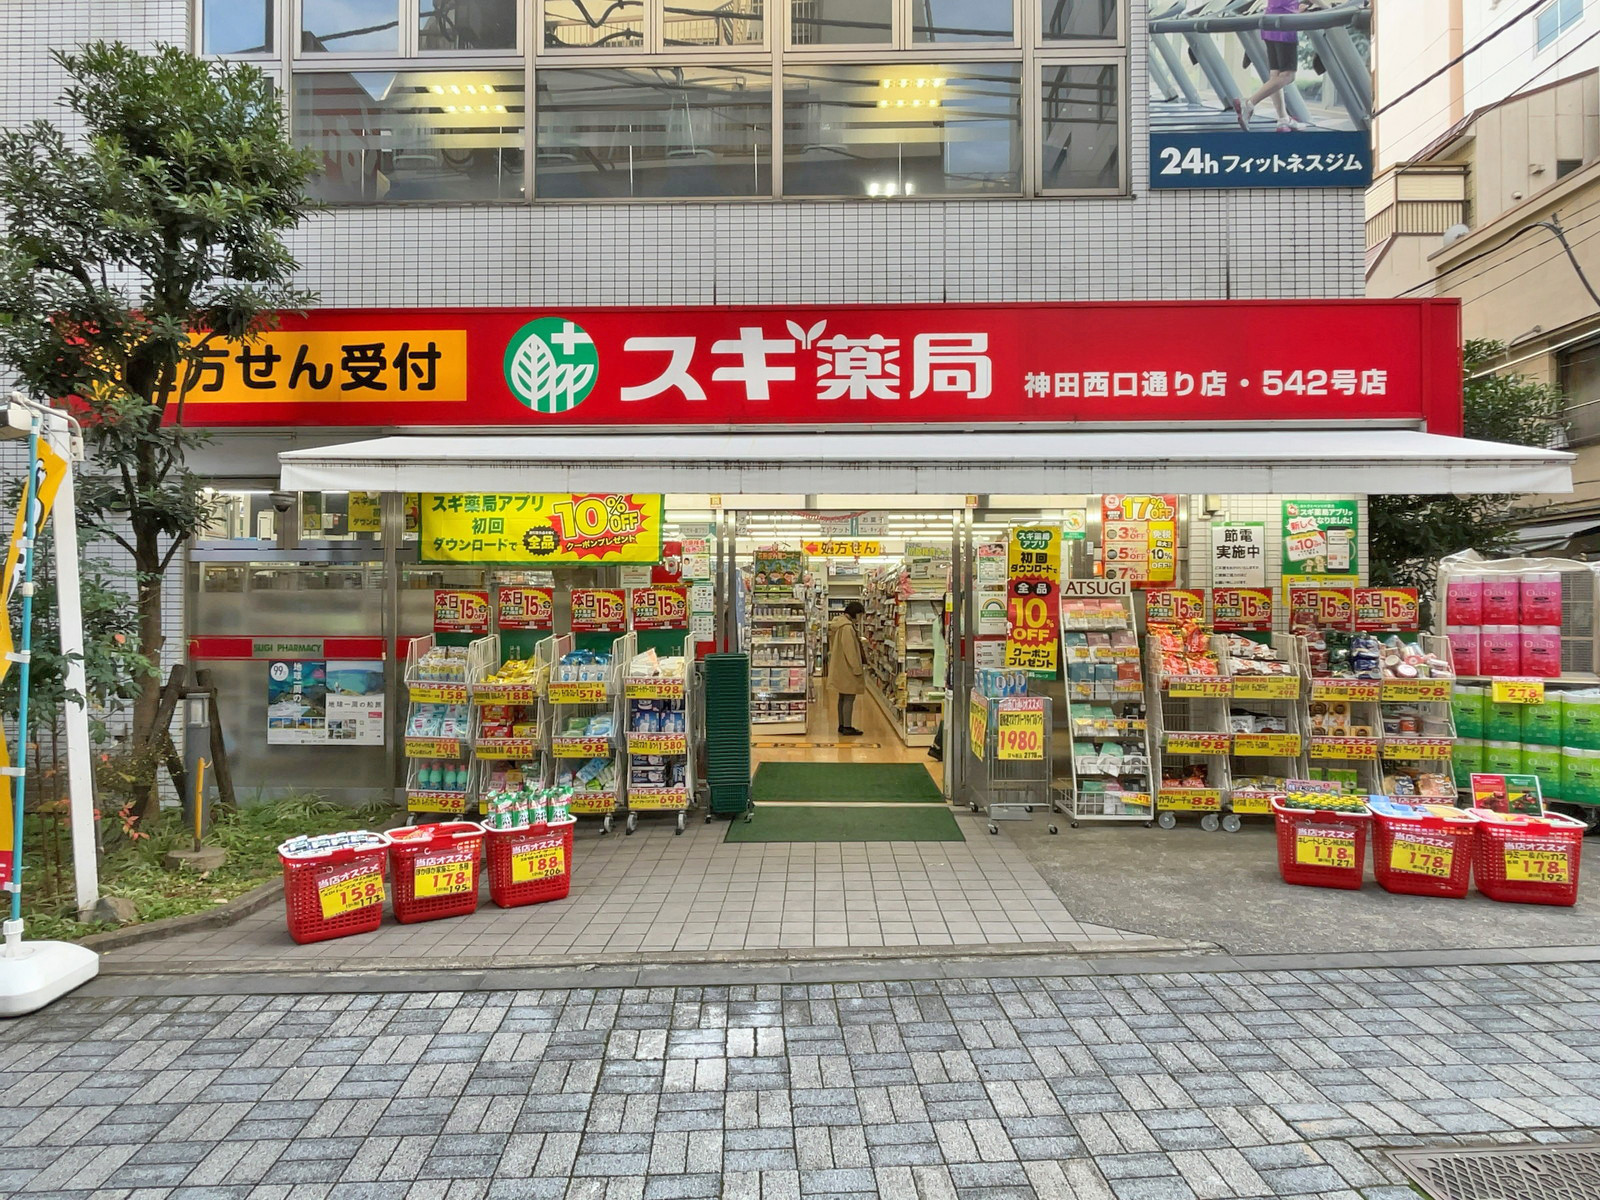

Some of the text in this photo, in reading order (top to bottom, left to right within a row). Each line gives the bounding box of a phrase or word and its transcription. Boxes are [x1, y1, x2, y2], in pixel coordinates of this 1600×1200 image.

[153, 342, 441, 392] 方せん受付
[621, 319, 993, 401] スギ薬局
[432, 494, 544, 512] スギ薬局アプリ
[472, 517, 504, 535] 初回
[1290, 519, 1314, 530] 新しく
[1224, 528, 1253, 542] 節電
[433, 537, 517, 552] ダウンロードで
[527, 535, 555, 550] 全品
[565, 535, 636, 551] クーポンプレゼント
[821, 541, 876, 555] 処方せん
[1022, 541, 1046, 549] アプリ
[1020, 552, 1048, 564] 初回
[1216, 544, 1260, 559] 実施中
[1010, 564, 1057, 573] ダウンロードで
[1017, 582, 1048, 594] 全品
[1065, 581, 1127, 595] ATSUGI
[437, 595, 458, 609] 本日
[501, 591, 523, 605] 本日
[573, 593, 595, 608] 本日
[635, 592, 656, 606] 本日
[1148, 592, 1171, 606] 本日
[1216, 592, 1239, 607] 本日
[1293, 593, 1318, 607] 本日
[1357, 593, 1382, 607] 本日
[1013, 629, 1051, 641] OFF
[253, 643, 322, 653] SUGI PHARMACY
[1013, 648, 1050, 658] クーポン
[1009, 658, 1053, 668] プレゼント
[1297, 828, 1355, 839] 当店オススメ
[1394, 832, 1454, 848] 当店オススメ
[512, 838, 563, 853] 当店オススメ
[1504, 842, 1567, 852] 当店オススメ
[416, 853, 473, 867] 当店オススメ
[318, 863, 379, 888] 当店オススメ
